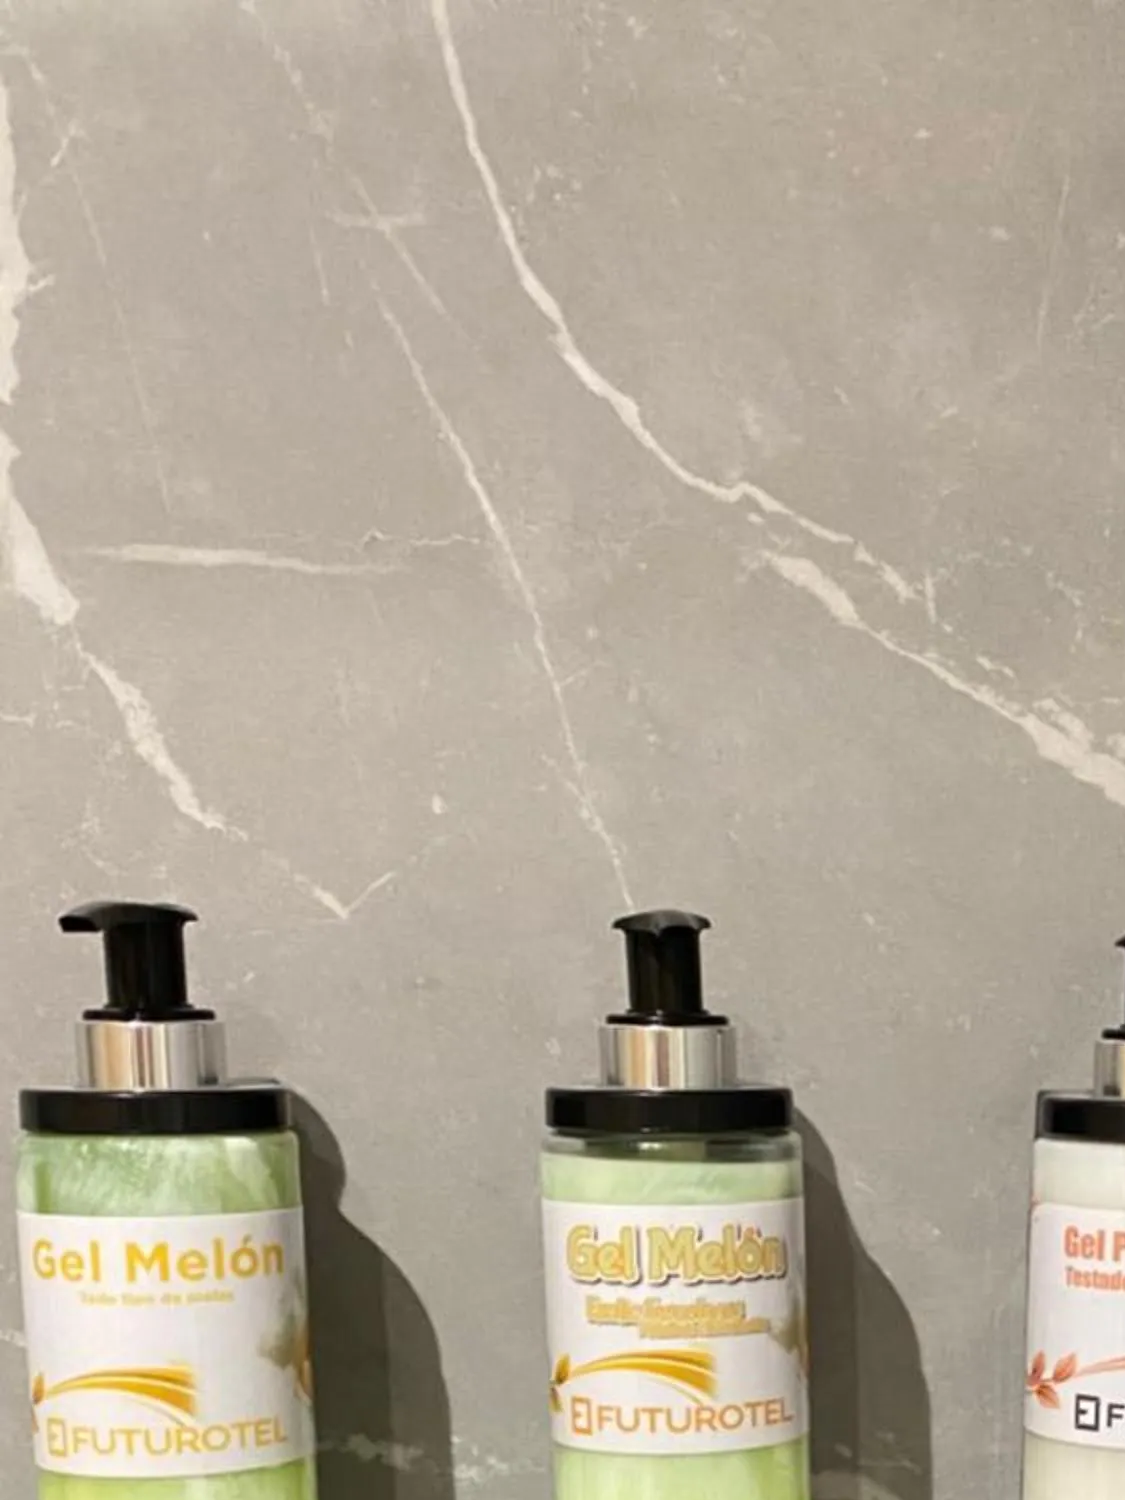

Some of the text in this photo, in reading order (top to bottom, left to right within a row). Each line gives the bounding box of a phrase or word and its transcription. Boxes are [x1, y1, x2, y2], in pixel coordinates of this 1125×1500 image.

[31, 1234, 286, 1282] Gel Melón
[566, 1222, 787, 1285] Gel Melón
[1064, 1225, 1105, 1262] Gel
[71, 1414, 288, 1457] FUTUROTEL
[597, 1397, 794, 1435] FUTUROTEL
